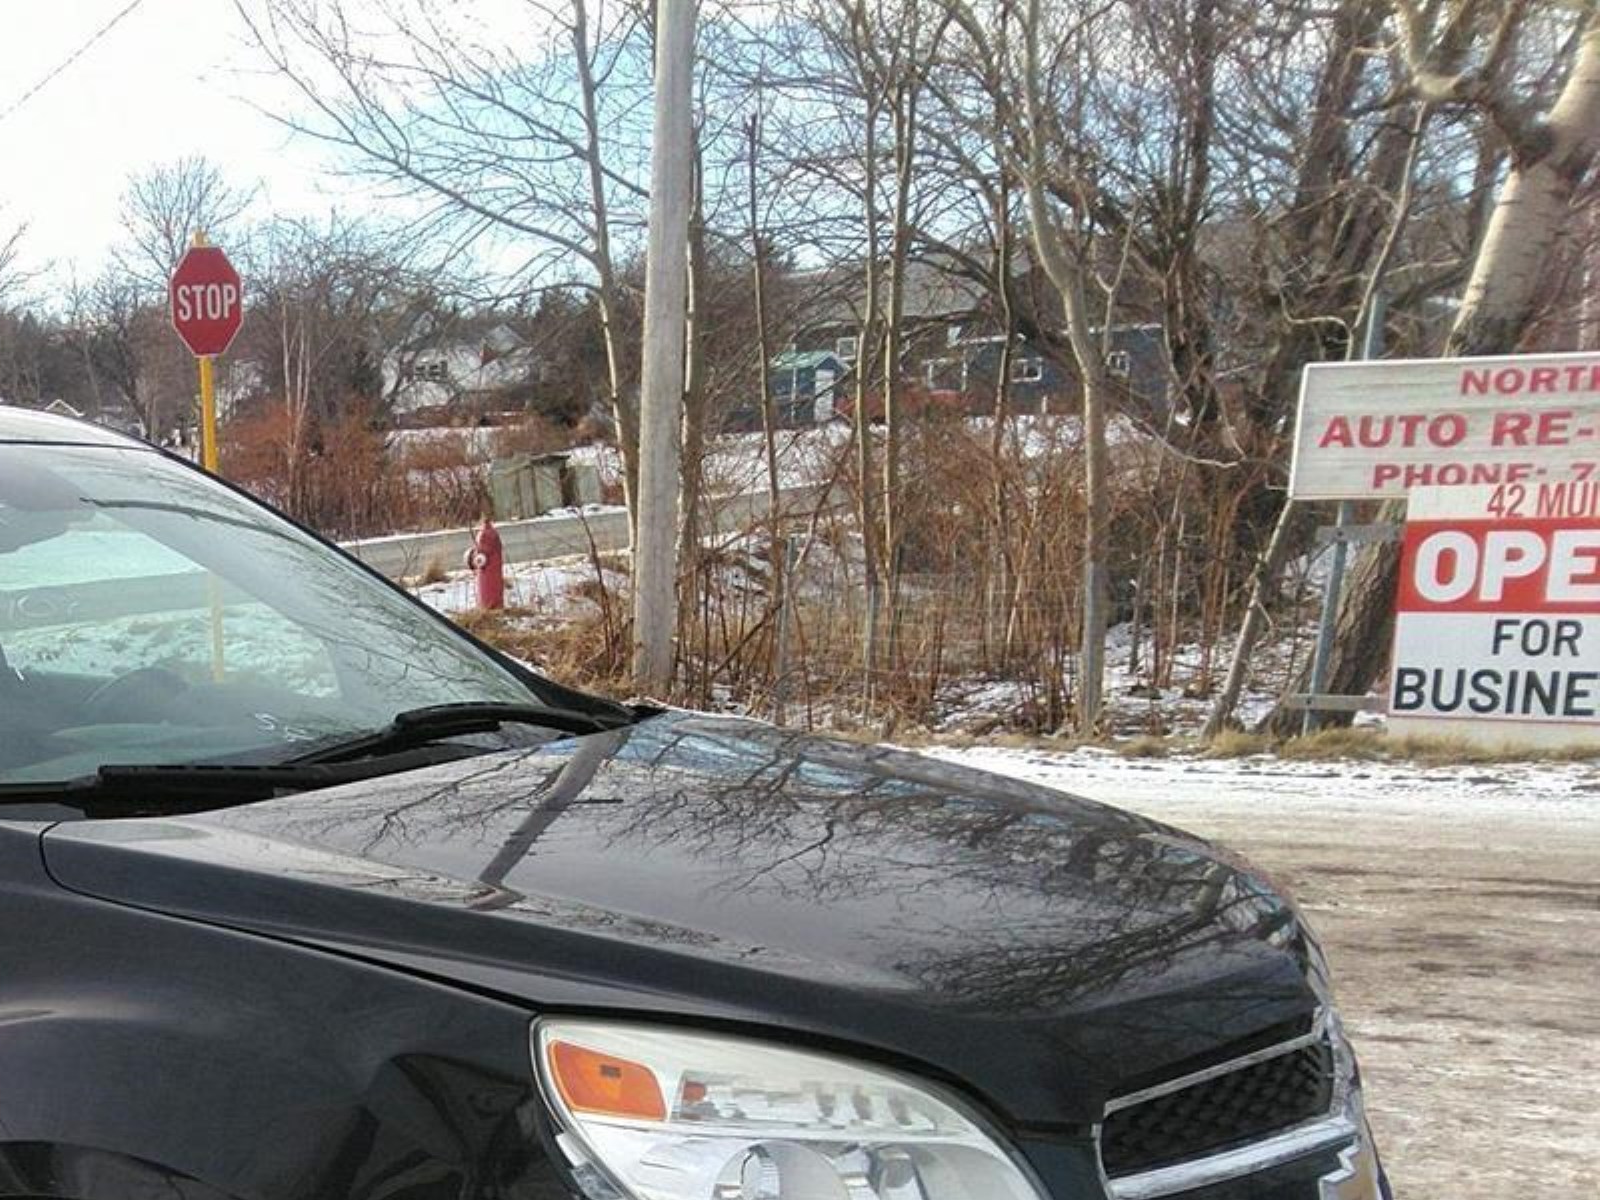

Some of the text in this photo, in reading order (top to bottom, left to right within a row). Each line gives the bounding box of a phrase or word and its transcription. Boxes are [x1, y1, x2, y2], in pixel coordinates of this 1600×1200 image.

[177, 283, 237, 321] STOP
[1319, 414, 1467, 449] AUTO
[1487, 484, 1526, 519] 42
[1413, 529, 1600, 603] OPE
[1492, 618, 1584, 657] FOR
[1393, 667, 1600, 717] BUSINE
